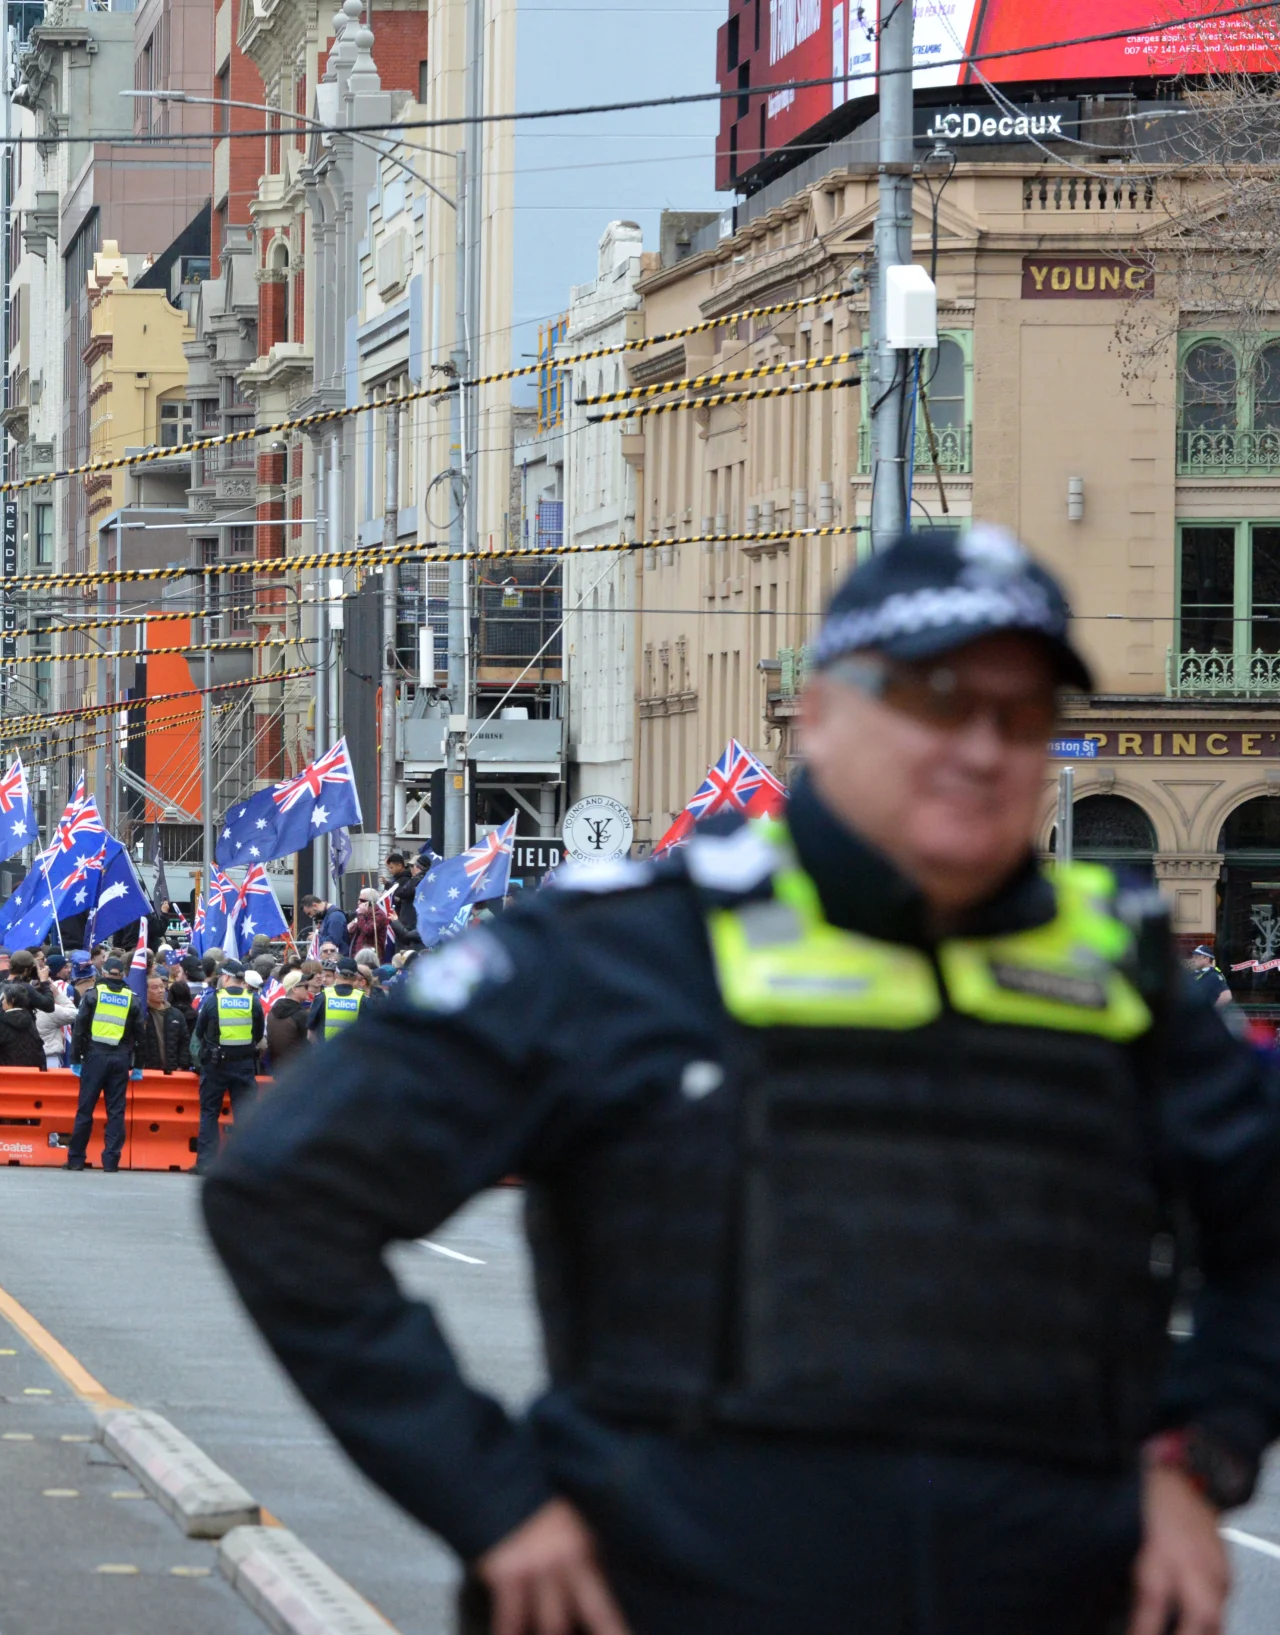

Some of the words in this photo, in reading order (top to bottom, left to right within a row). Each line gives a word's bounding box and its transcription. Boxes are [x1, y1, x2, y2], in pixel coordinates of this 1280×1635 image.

[1126, 35, 1160, 44] charges
[1124, 46, 1140, 54] 007
[1142, 45, 1158, 53] 457
[1161, 45, 1176, 53] 141
[1204, 44, 1220, 52] and
[926, 112, 1062, 138] JCDecaux
[1029, 266, 1146, 291] YOUNG
[5, 505, 15, 643] RENDEVOUS
[1082, 740, 1095, 752] St
[1085, 733, 1280, 755] PRINCE'
[565, 803, 584, 829] YOUNG
[586, 798, 603, 806] AND
[605, 800, 631, 829] JACKSON
[100, 993, 128, 1007] Police
[221, 999, 249, 1009] Police
[328, 999, 357, 1010] Police
